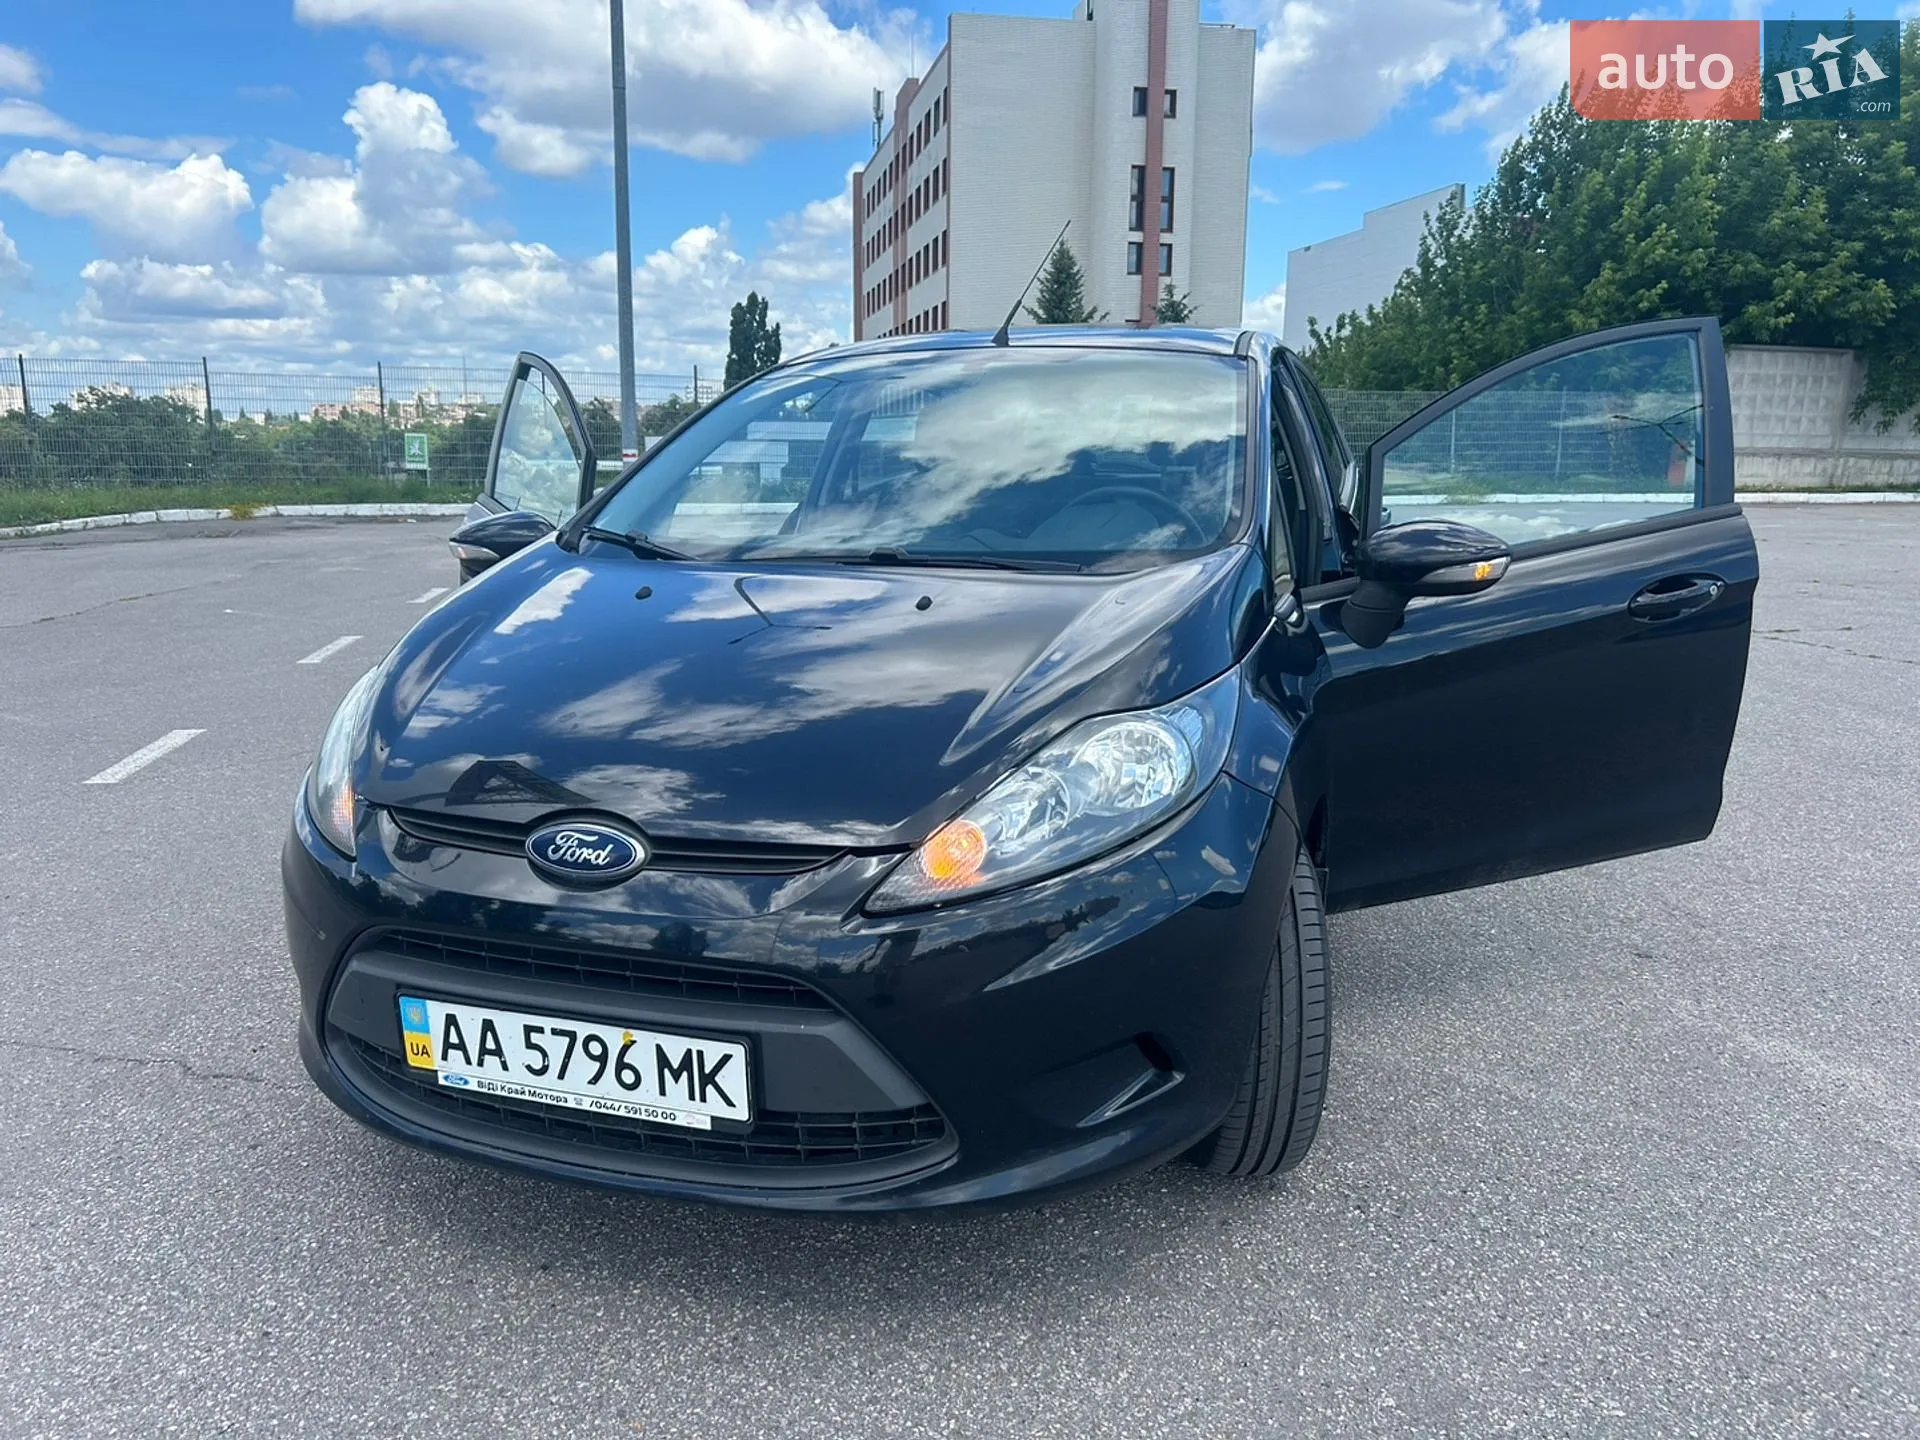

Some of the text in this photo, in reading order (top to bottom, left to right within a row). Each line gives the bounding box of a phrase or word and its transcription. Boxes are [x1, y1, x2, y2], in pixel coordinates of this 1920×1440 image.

[547, 830, 614, 866] Ford
[410, 1042, 431, 1058] UA
[441, 1012, 737, 1108] AA 5796 MK
[499, 1084, 527, 1096] Край
[528, 1089, 568, 1104] Мотора
[624, 1105, 642, 1116] 591
[645, 1109, 659, 1118] 50
[661, 1111, 677, 1121] 00
